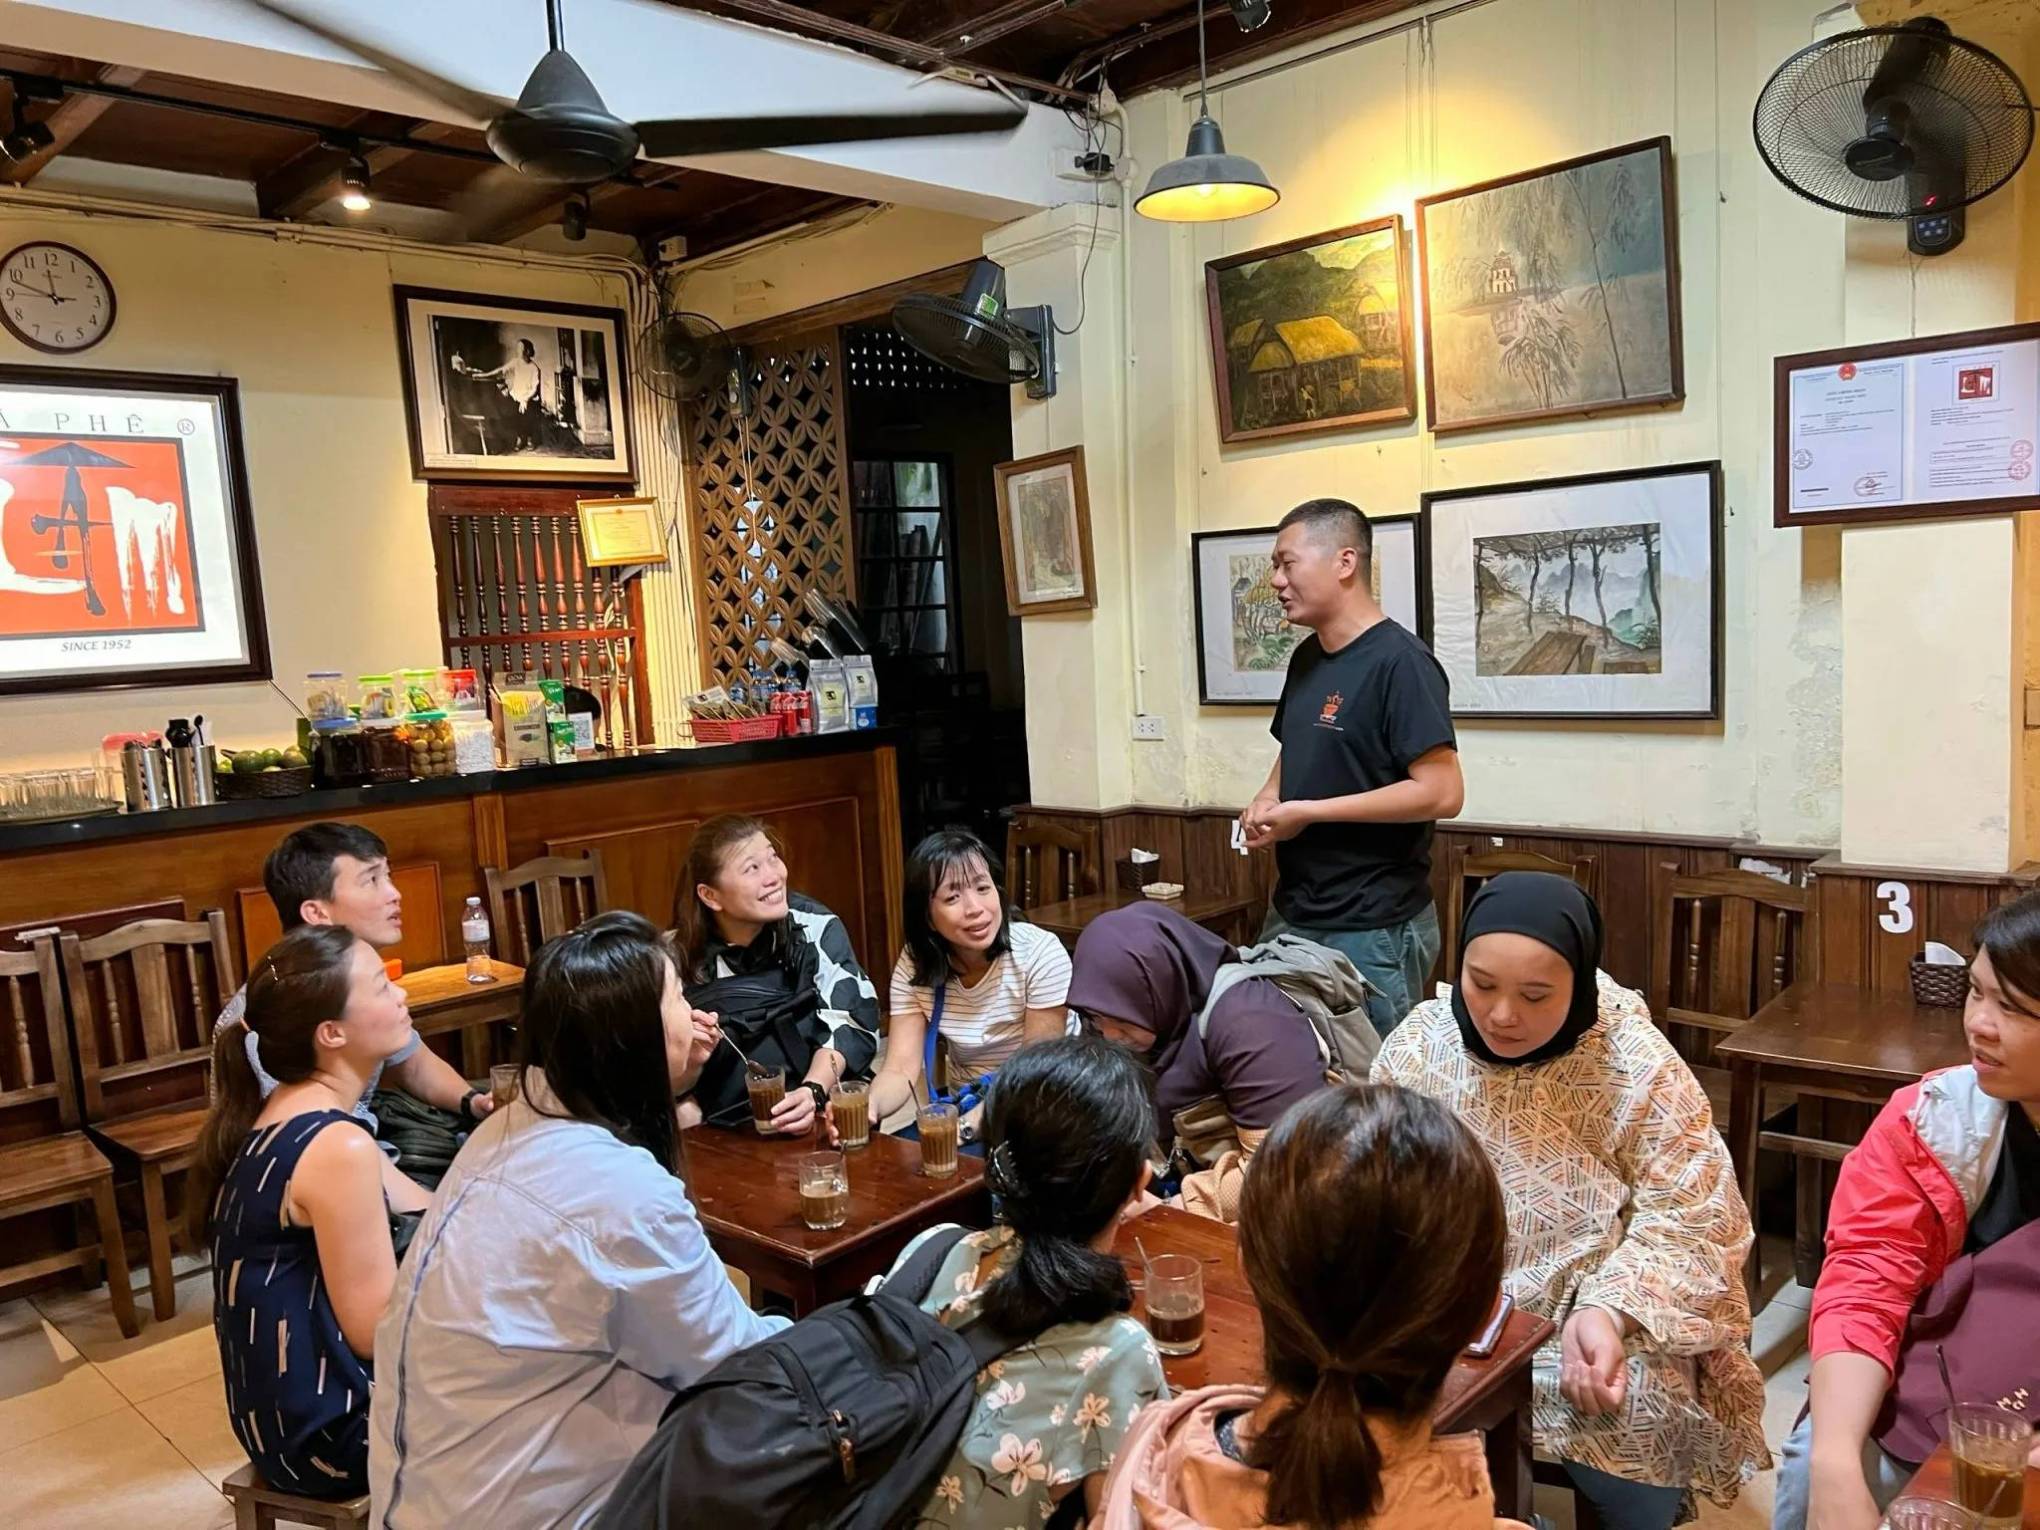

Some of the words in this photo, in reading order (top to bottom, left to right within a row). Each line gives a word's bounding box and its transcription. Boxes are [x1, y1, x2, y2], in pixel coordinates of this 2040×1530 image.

[23, 255, 35, 269] 11
[44, 252, 59, 266] 12
[70, 260, 76, 273] 1
[9, 268, 23, 282] 10
[85, 275, 94, 289] 2
[6, 287, 15, 300] 9
[94, 295, 101, 309] 3
[15, 307, 24, 321] 8
[89, 314, 97, 326] 4
[32, 324, 41, 338] 7
[55, 330, 64, 344] 6
[76, 327, 84, 340] 5
[55, 412, 144, 433] PHÊ
[61, 641, 99, 652] SINCE
[102, 639, 132, 650] 1952
[1876, 881, 1913, 934] 3
